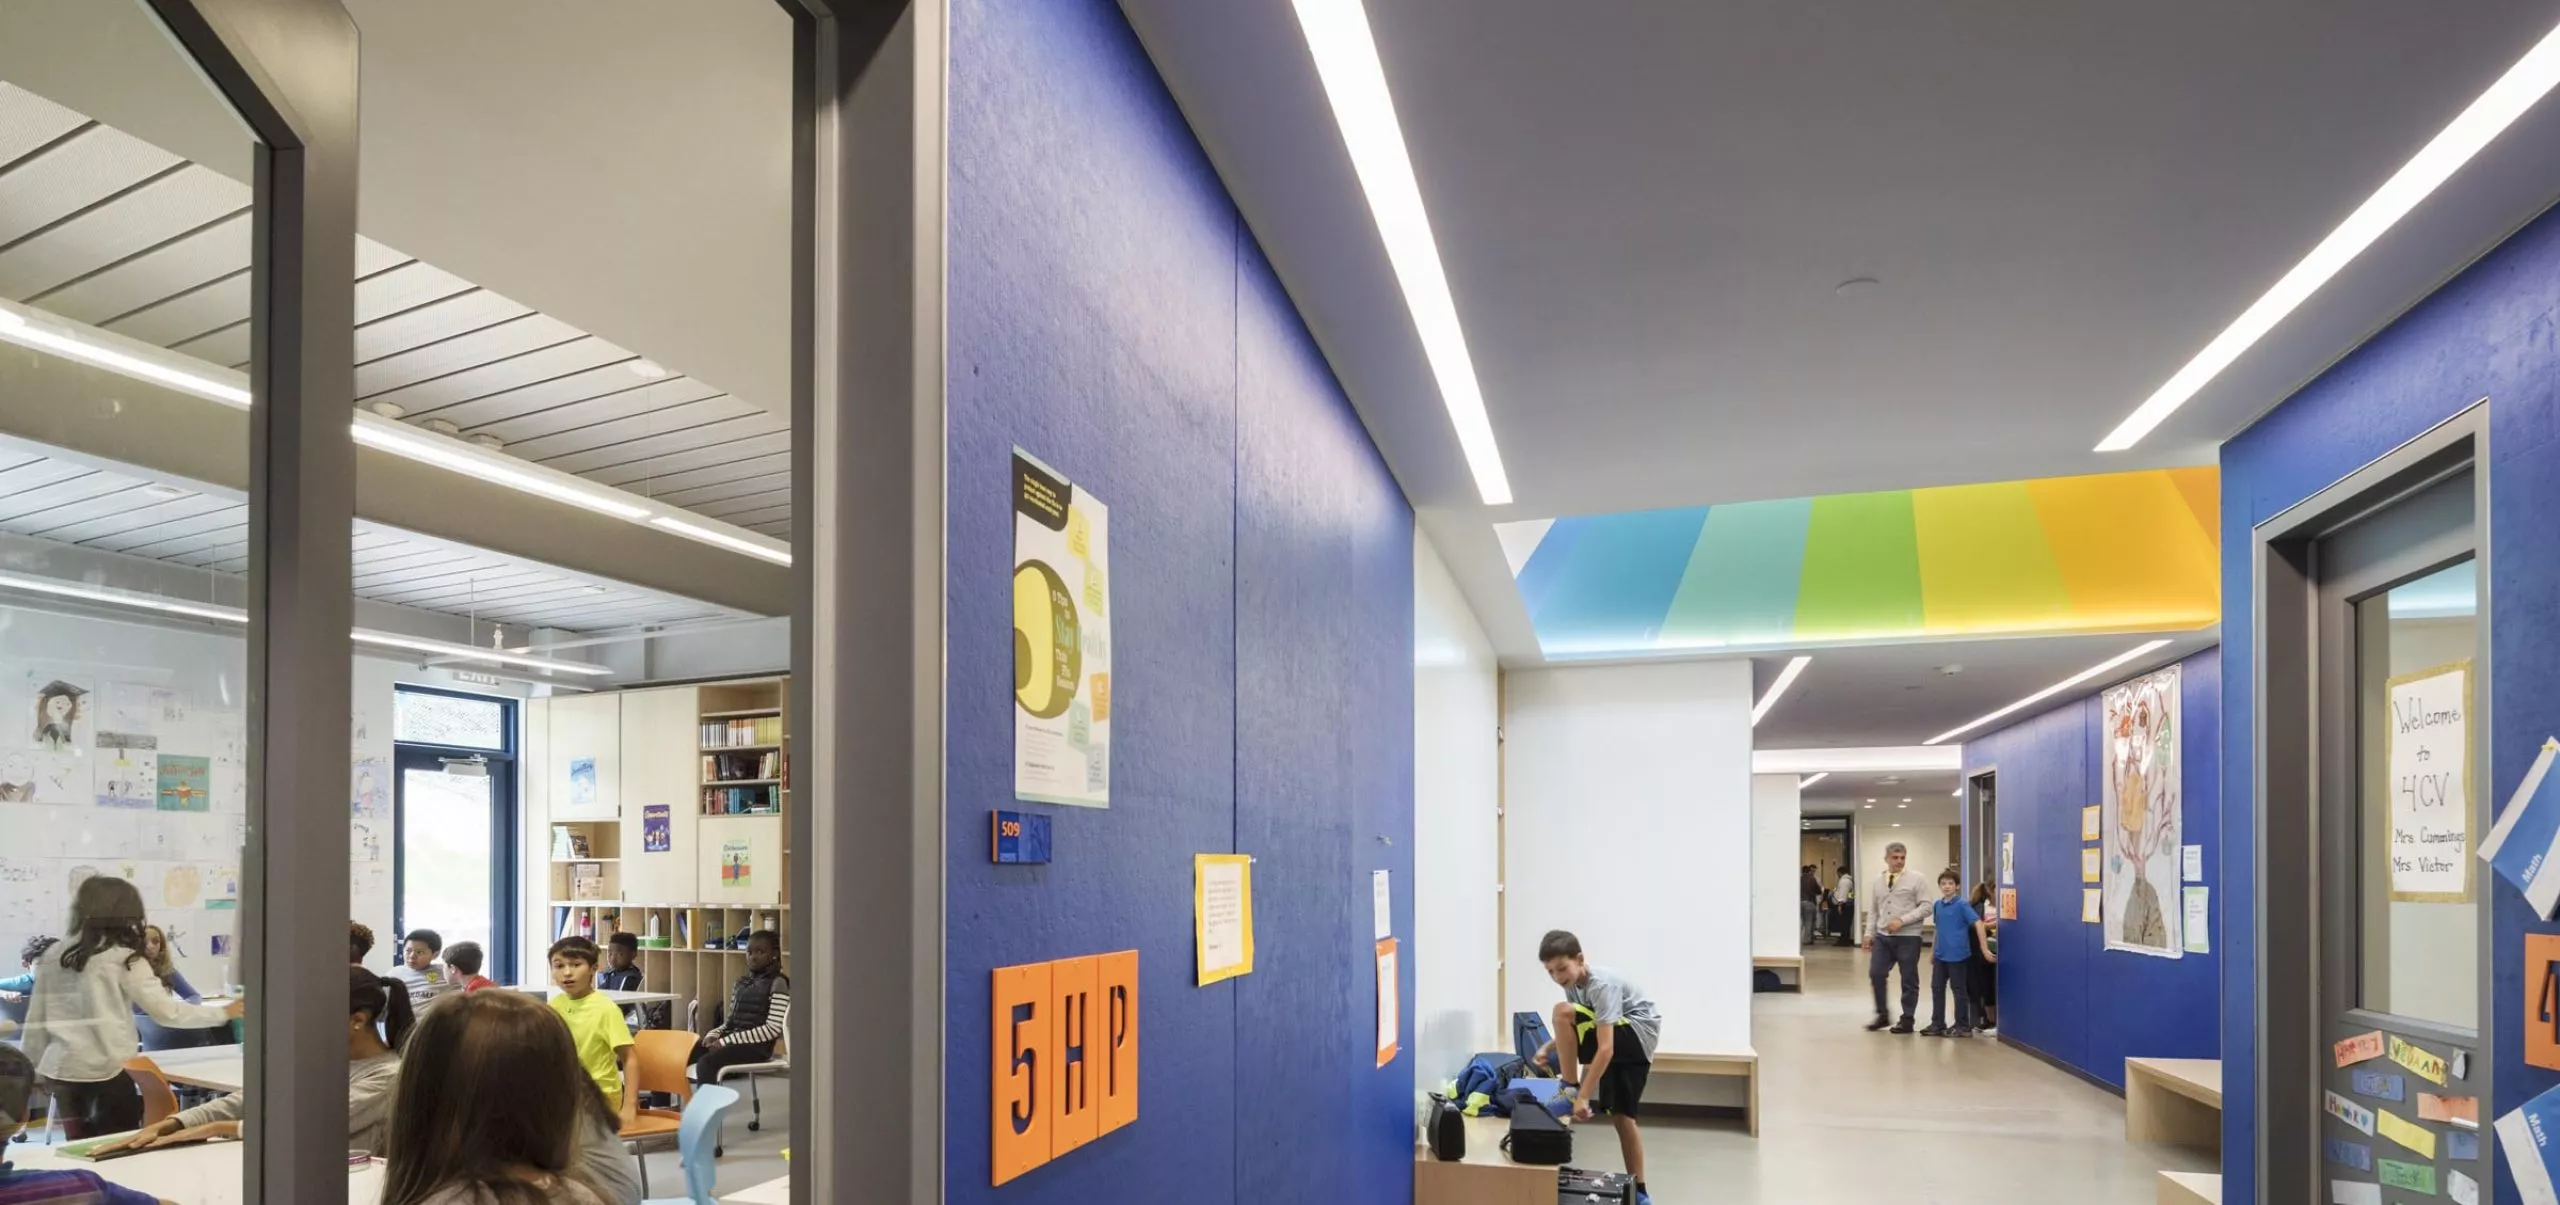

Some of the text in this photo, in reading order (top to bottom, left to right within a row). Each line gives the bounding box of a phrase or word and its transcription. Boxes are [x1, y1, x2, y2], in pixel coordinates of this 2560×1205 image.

[2393, 697, 2461, 734] Welcome
[2416, 745, 2431, 762] to
[2402, 772, 2450, 812] 4CV
[1001, 820, 1021, 837] 509
[2394, 826, 2465, 853] Mrs Cummings
[2419, 856, 2454, 873] Victor
[2521, 853, 2543, 883] Math
[2527, 1112, 2549, 1148] Math
